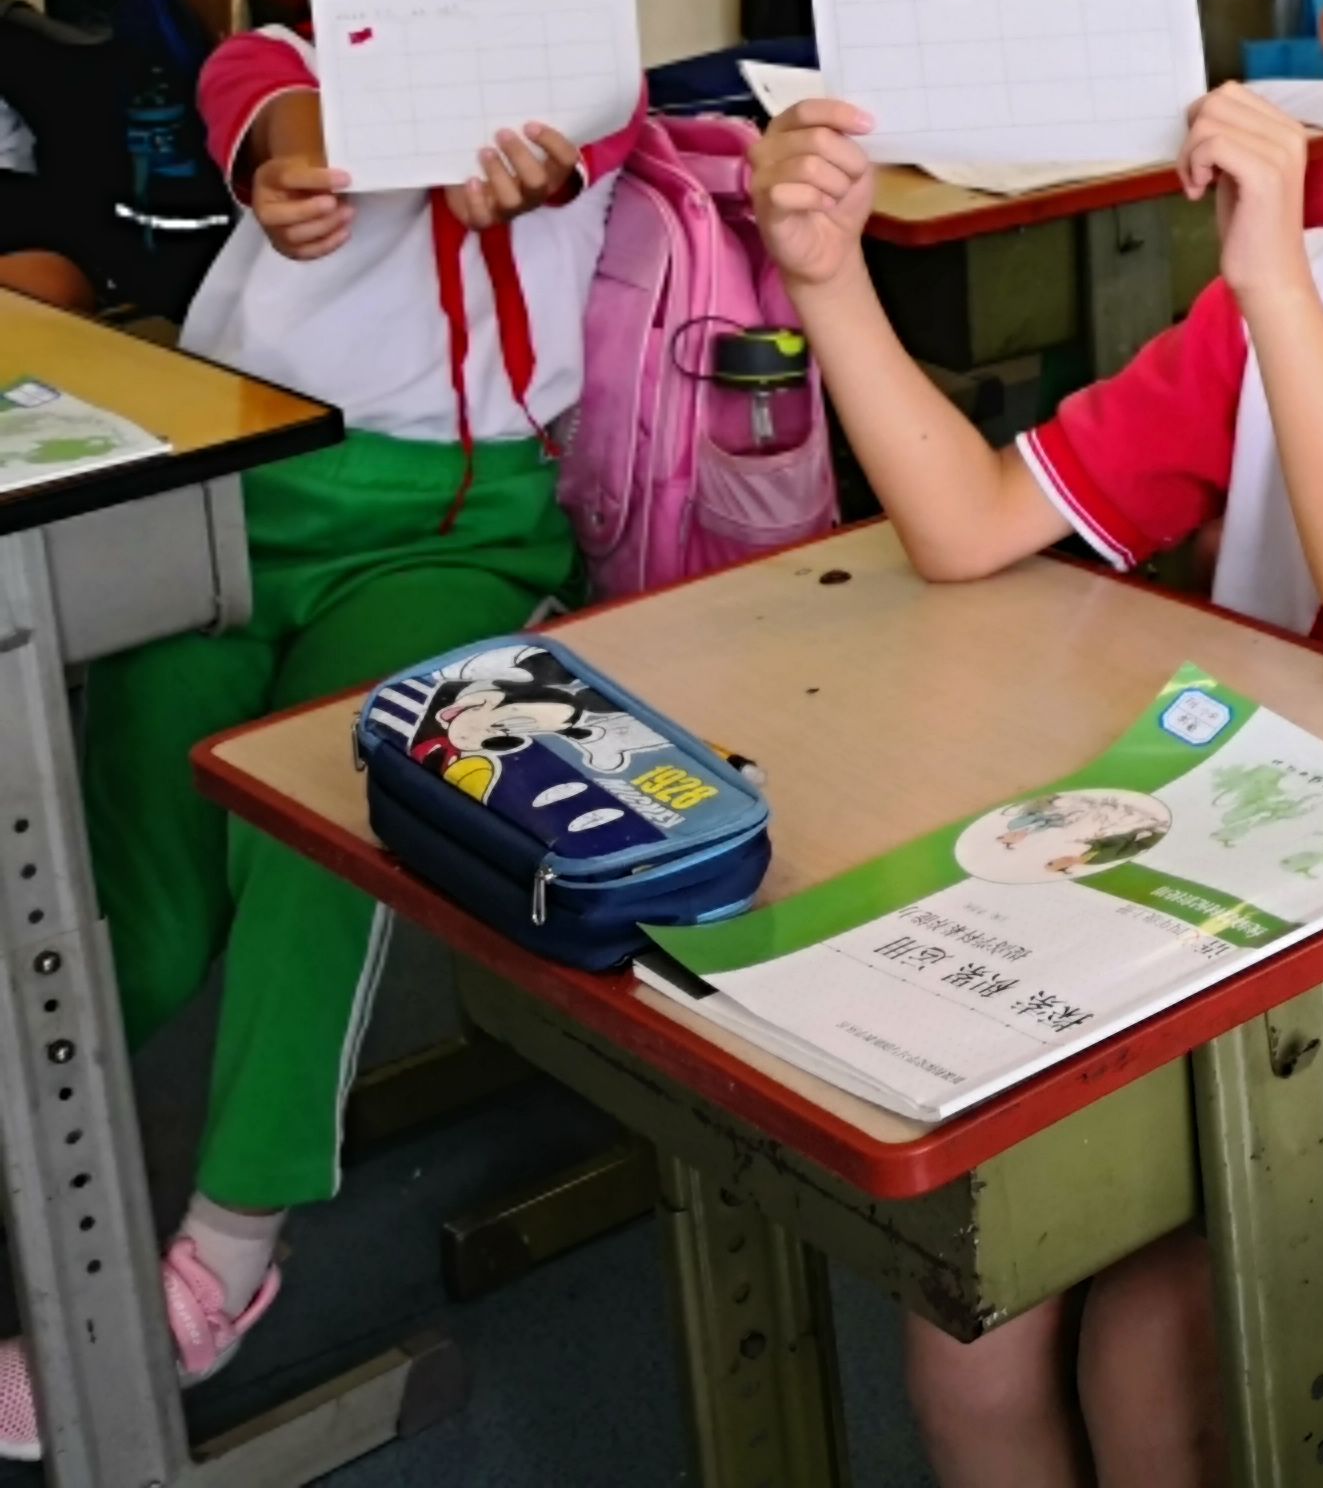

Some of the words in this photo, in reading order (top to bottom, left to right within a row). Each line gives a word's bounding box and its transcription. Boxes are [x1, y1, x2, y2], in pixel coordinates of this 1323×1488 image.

[631, 765, 719, 809] 1928
[872, 933, 953, 970] 运用
[891, 902, 1035, 963] 提高学科素养能力
[937, 961, 1021, 999] 积累
[1005, 989, 1096, 1034] 探索
